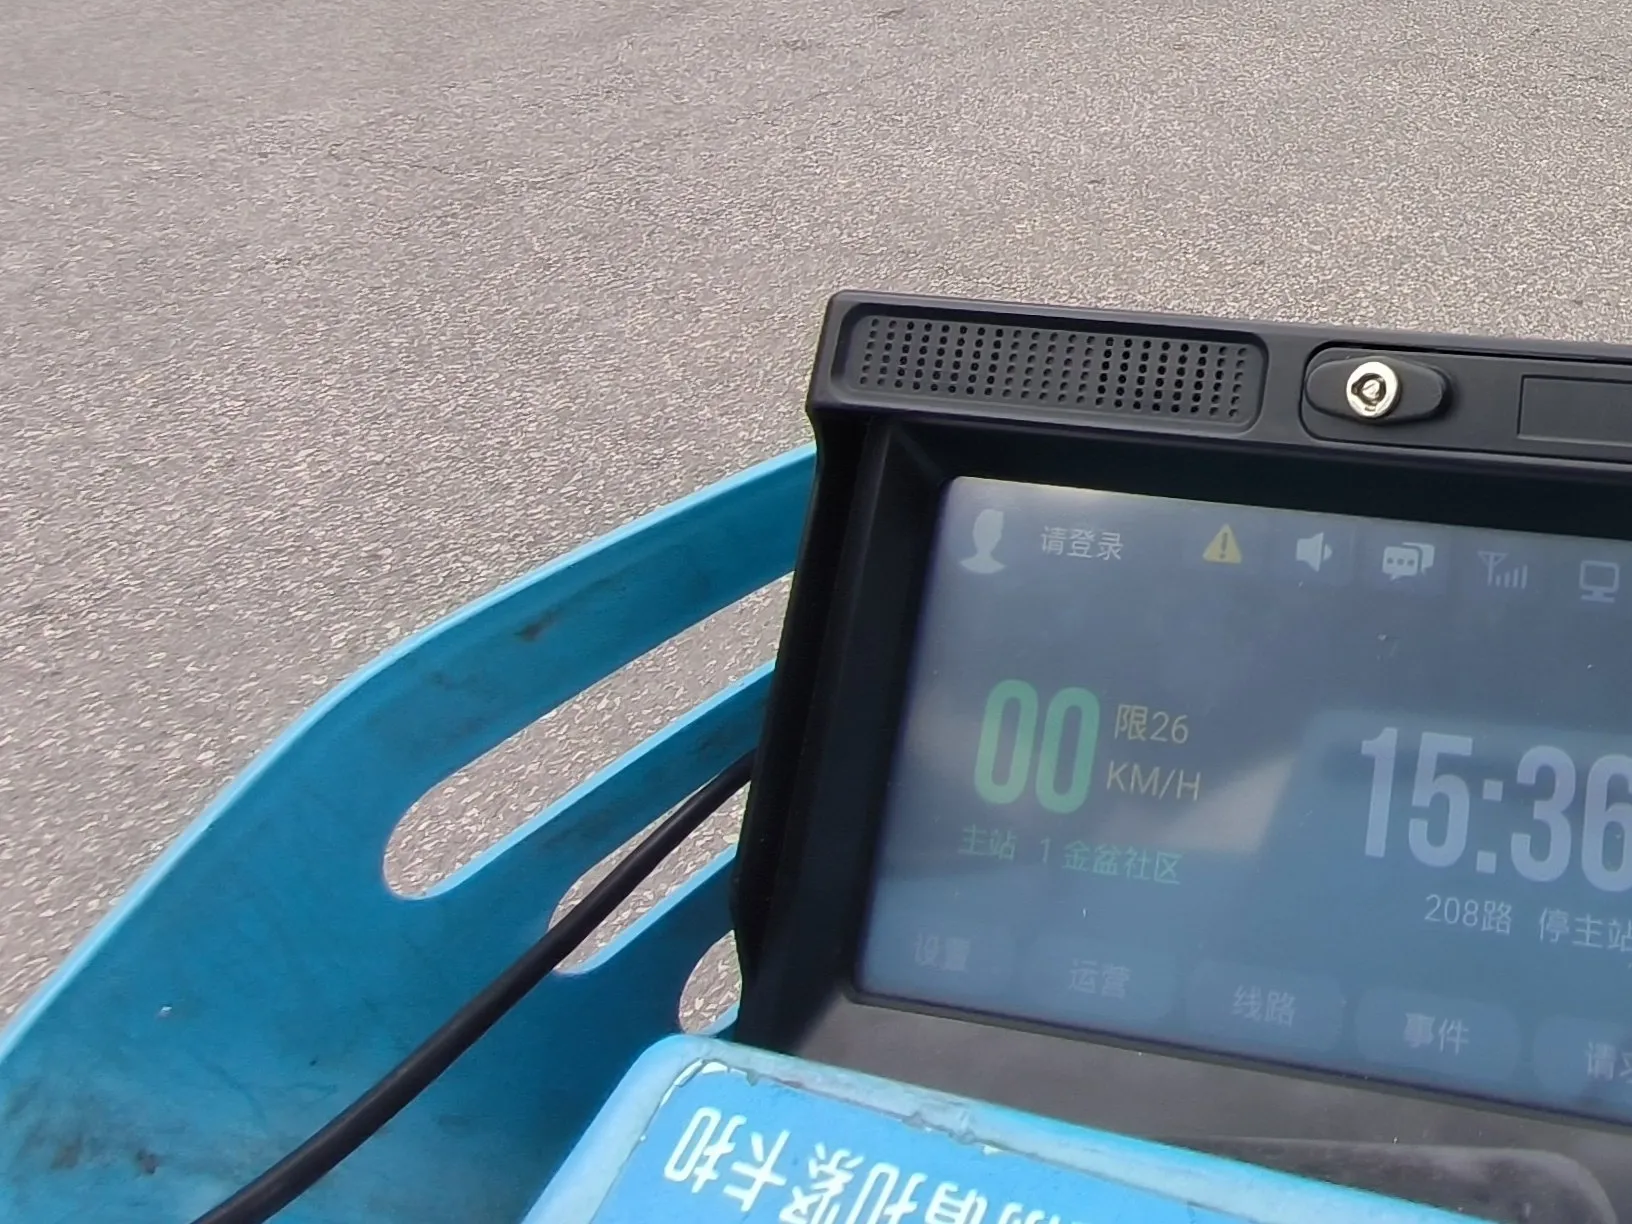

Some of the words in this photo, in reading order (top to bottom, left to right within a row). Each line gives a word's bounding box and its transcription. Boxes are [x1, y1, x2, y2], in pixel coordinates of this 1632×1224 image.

[1040, 524, 1124, 564] 请登录
[972, 676, 1100, 815] 00
[1114, 703, 1191, 746] 限26
[1105, 759, 1202, 803] KM/H
[957, 822, 1017, 863] 主站
[1060, 837, 1184, 888] 金盆社区
[1424, 891, 1513, 938] 208路
[912, 932, 970, 975] 设置
[1067, 957, 1132, 1001] 运营
[1232, 983, 1298, 1030] 线路
[1403, 1010, 1472, 1057] 事件
